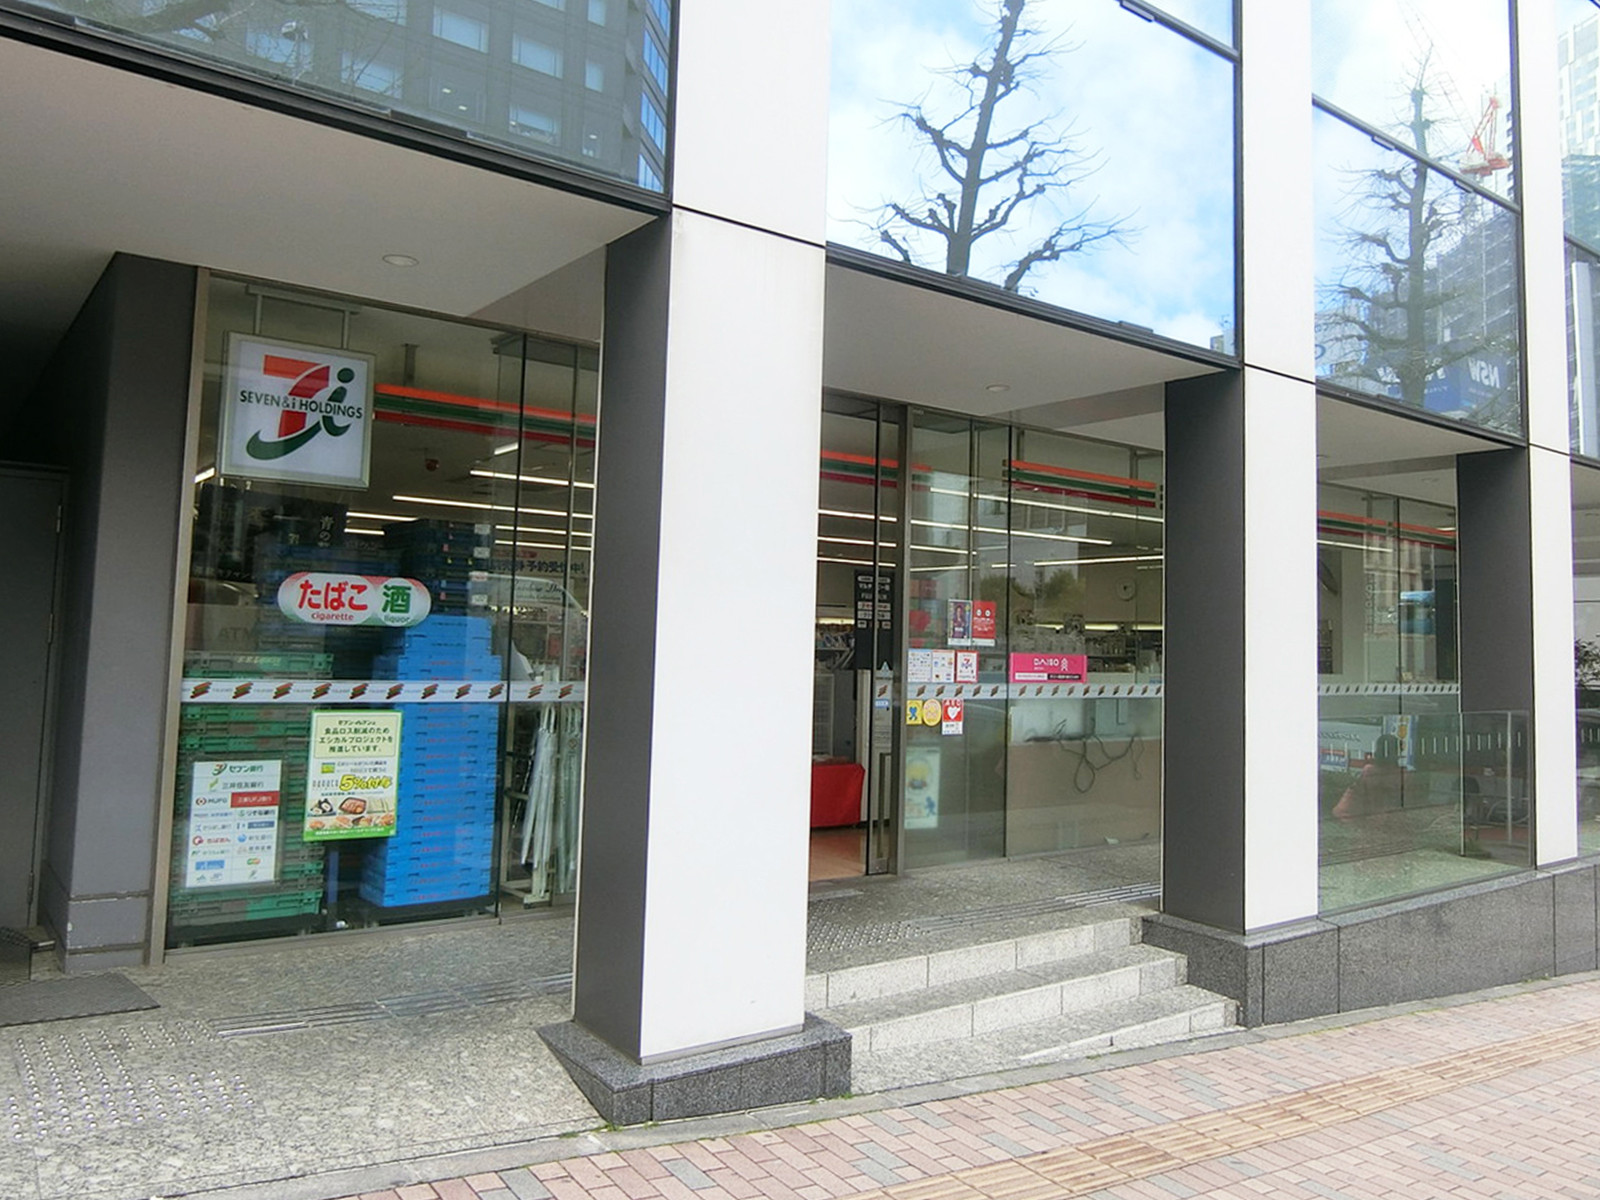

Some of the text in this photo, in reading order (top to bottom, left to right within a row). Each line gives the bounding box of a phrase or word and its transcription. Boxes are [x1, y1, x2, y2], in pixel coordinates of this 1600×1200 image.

[299, 400, 363, 419] HOLDINGS
[297, 580, 411, 613] たばこ 酒
[311, 612, 410, 623] cigarette liquor
[1033, 657, 1059, 667] DAISO
[324, 727, 390, 735] 食品ロス削減のため
[318, 736, 393, 744] エシカルプロジェクトを
[229, 765, 263, 773] セブン銀行
